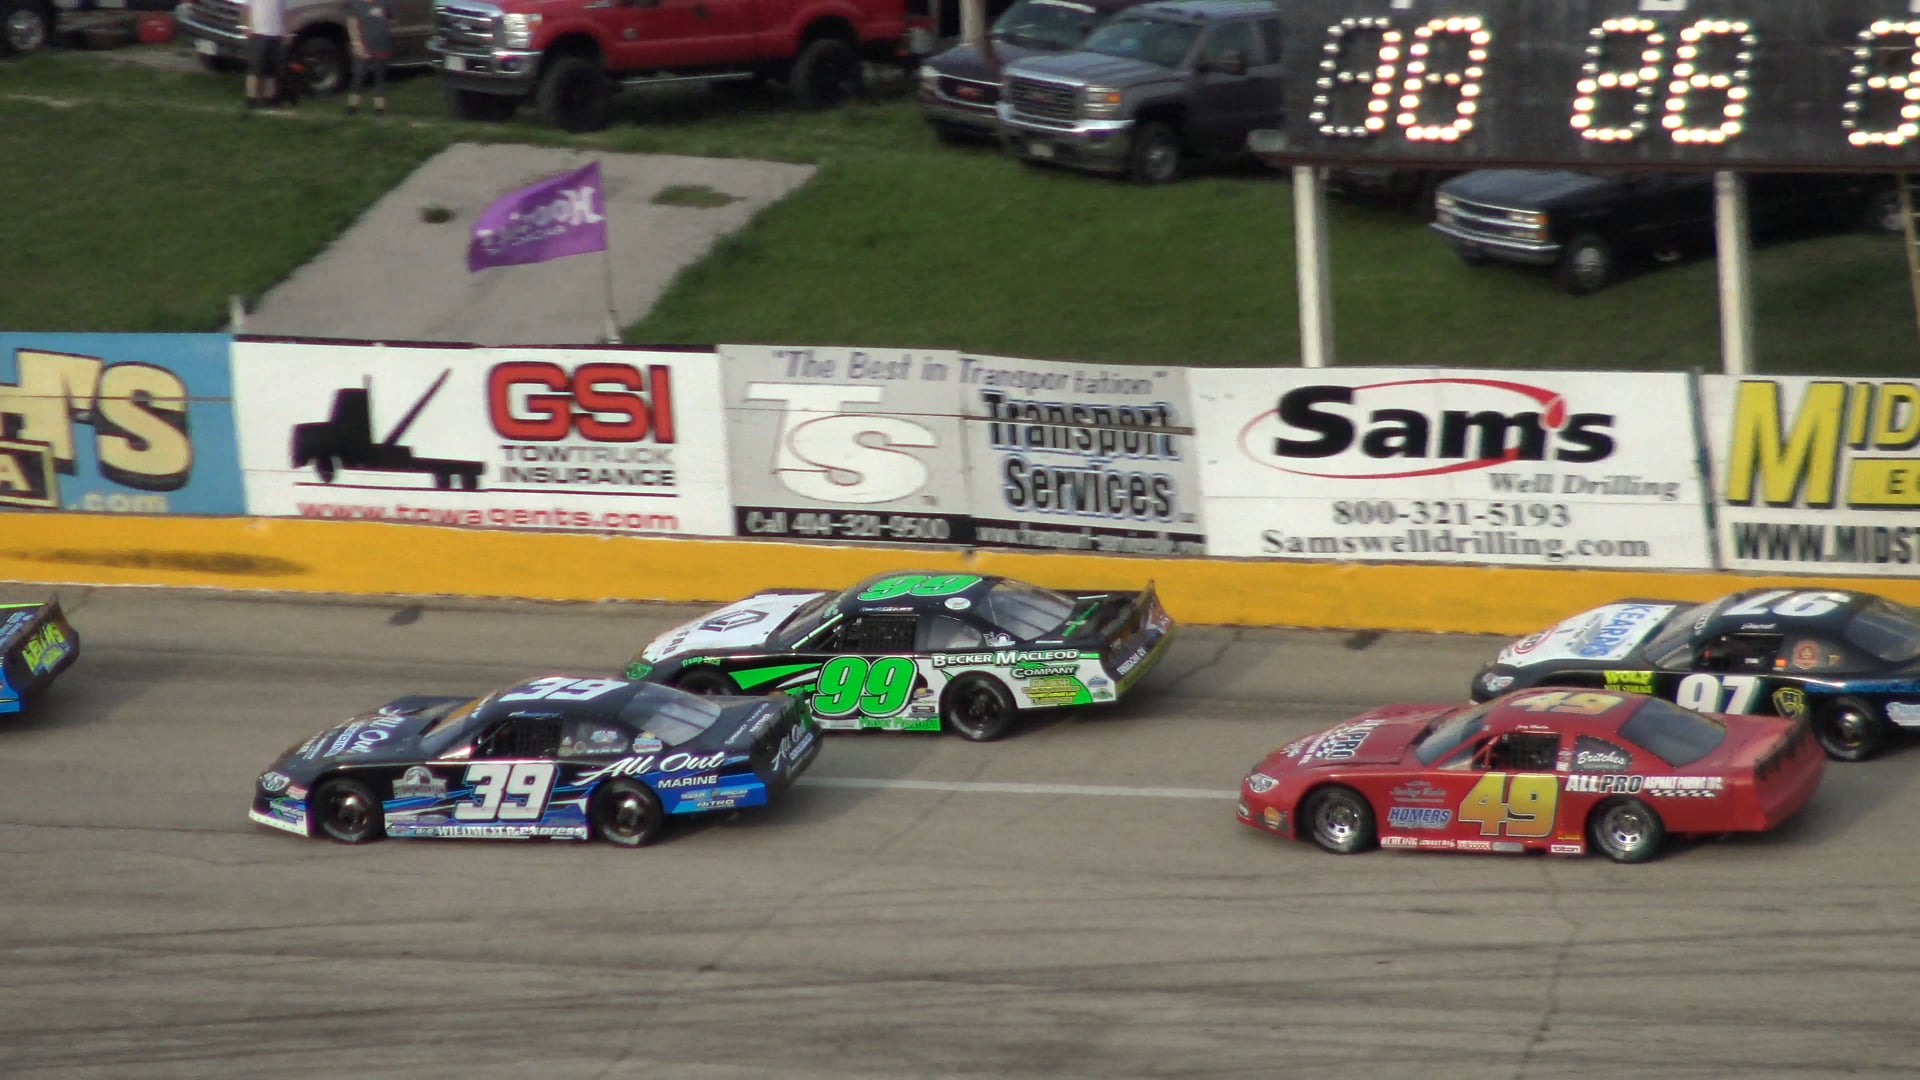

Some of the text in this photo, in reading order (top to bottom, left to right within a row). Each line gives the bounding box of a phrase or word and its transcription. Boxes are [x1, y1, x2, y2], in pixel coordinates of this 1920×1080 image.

[847, 351, 912, 381] Best
[920, 356, 949, 382] in
[487, 360, 676, 444] GSI
[980, 388, 1184, 464] Transport
[501, 466, 677, 487] INSURANCE
[1003, 453, 1178, 524] Services
[1488, 471, 1681, 501] Well Drilling
[70, 492, 168, 513] .com
[297, 502, 680, 530] www.towagents.com
[1332, 499, 1572, 528] 800-321-5193
[1260, 529, 1651, 562] Samswelldrilling.com
[857, 574, 983, 602] 99
[931, 652, 993, 669] BECKER
[1011, 664, 1077, 681] COMPANY
[498, 676, 630, 702] 39
[812, 654, 918, 719] 99
[1676, 672, 1757, 716] 97
[1508, 690, 1624, 717] 49
[570, 751, 726, 787] All Out
[657, 774, 718, 789] MARINE
[453, 762, 559, 823] 39
[1565, 774, 1600, 793] ALL
[1599, 774, 1644, 794] PRO
[1388, 807, 1453, 824] HOMERS
[1458, 771, 1560, 838] 49
